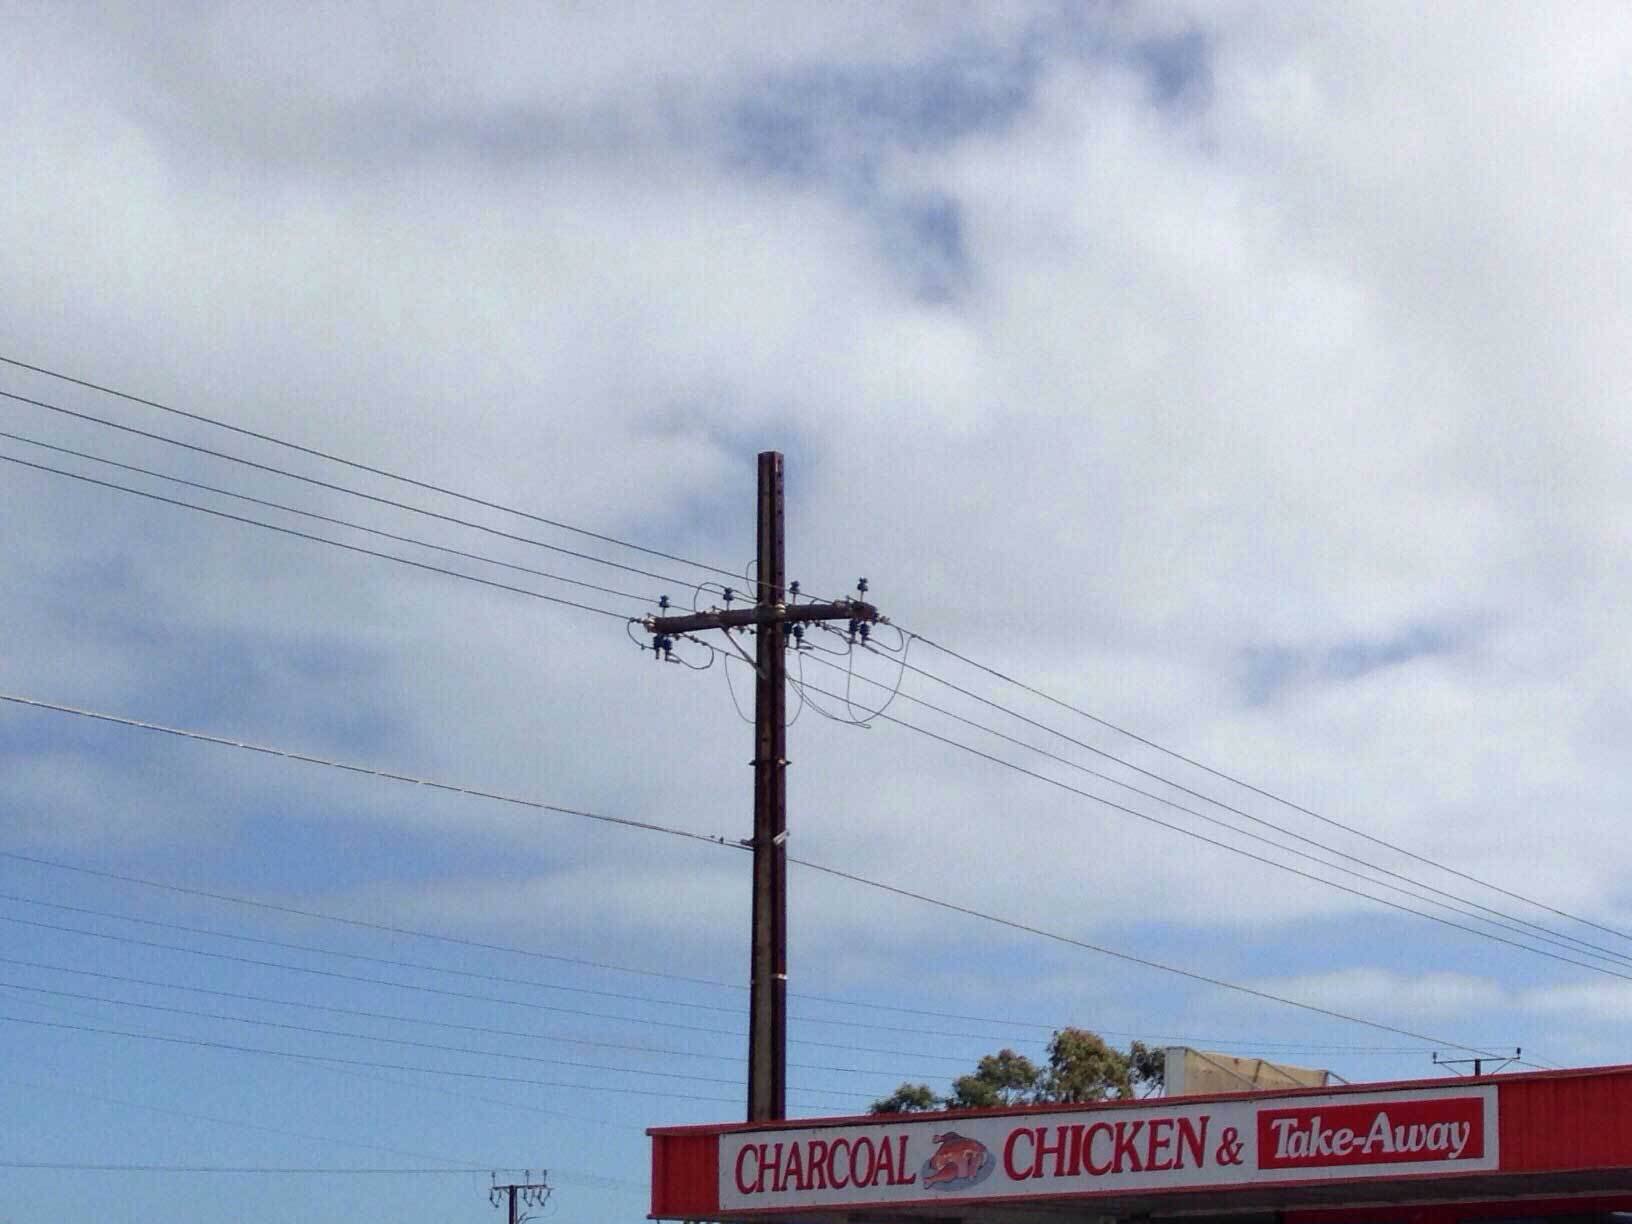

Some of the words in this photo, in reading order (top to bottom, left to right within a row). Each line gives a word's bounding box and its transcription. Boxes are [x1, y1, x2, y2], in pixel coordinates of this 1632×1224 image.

[735, 1134, 916, 1195] CHARCOAL
[1003, 1115, 1210, 1182] CHICKEN
[1216, 1133, 1244, 1166] &
[1270, 1114, 1471, 1162] Take-Away
